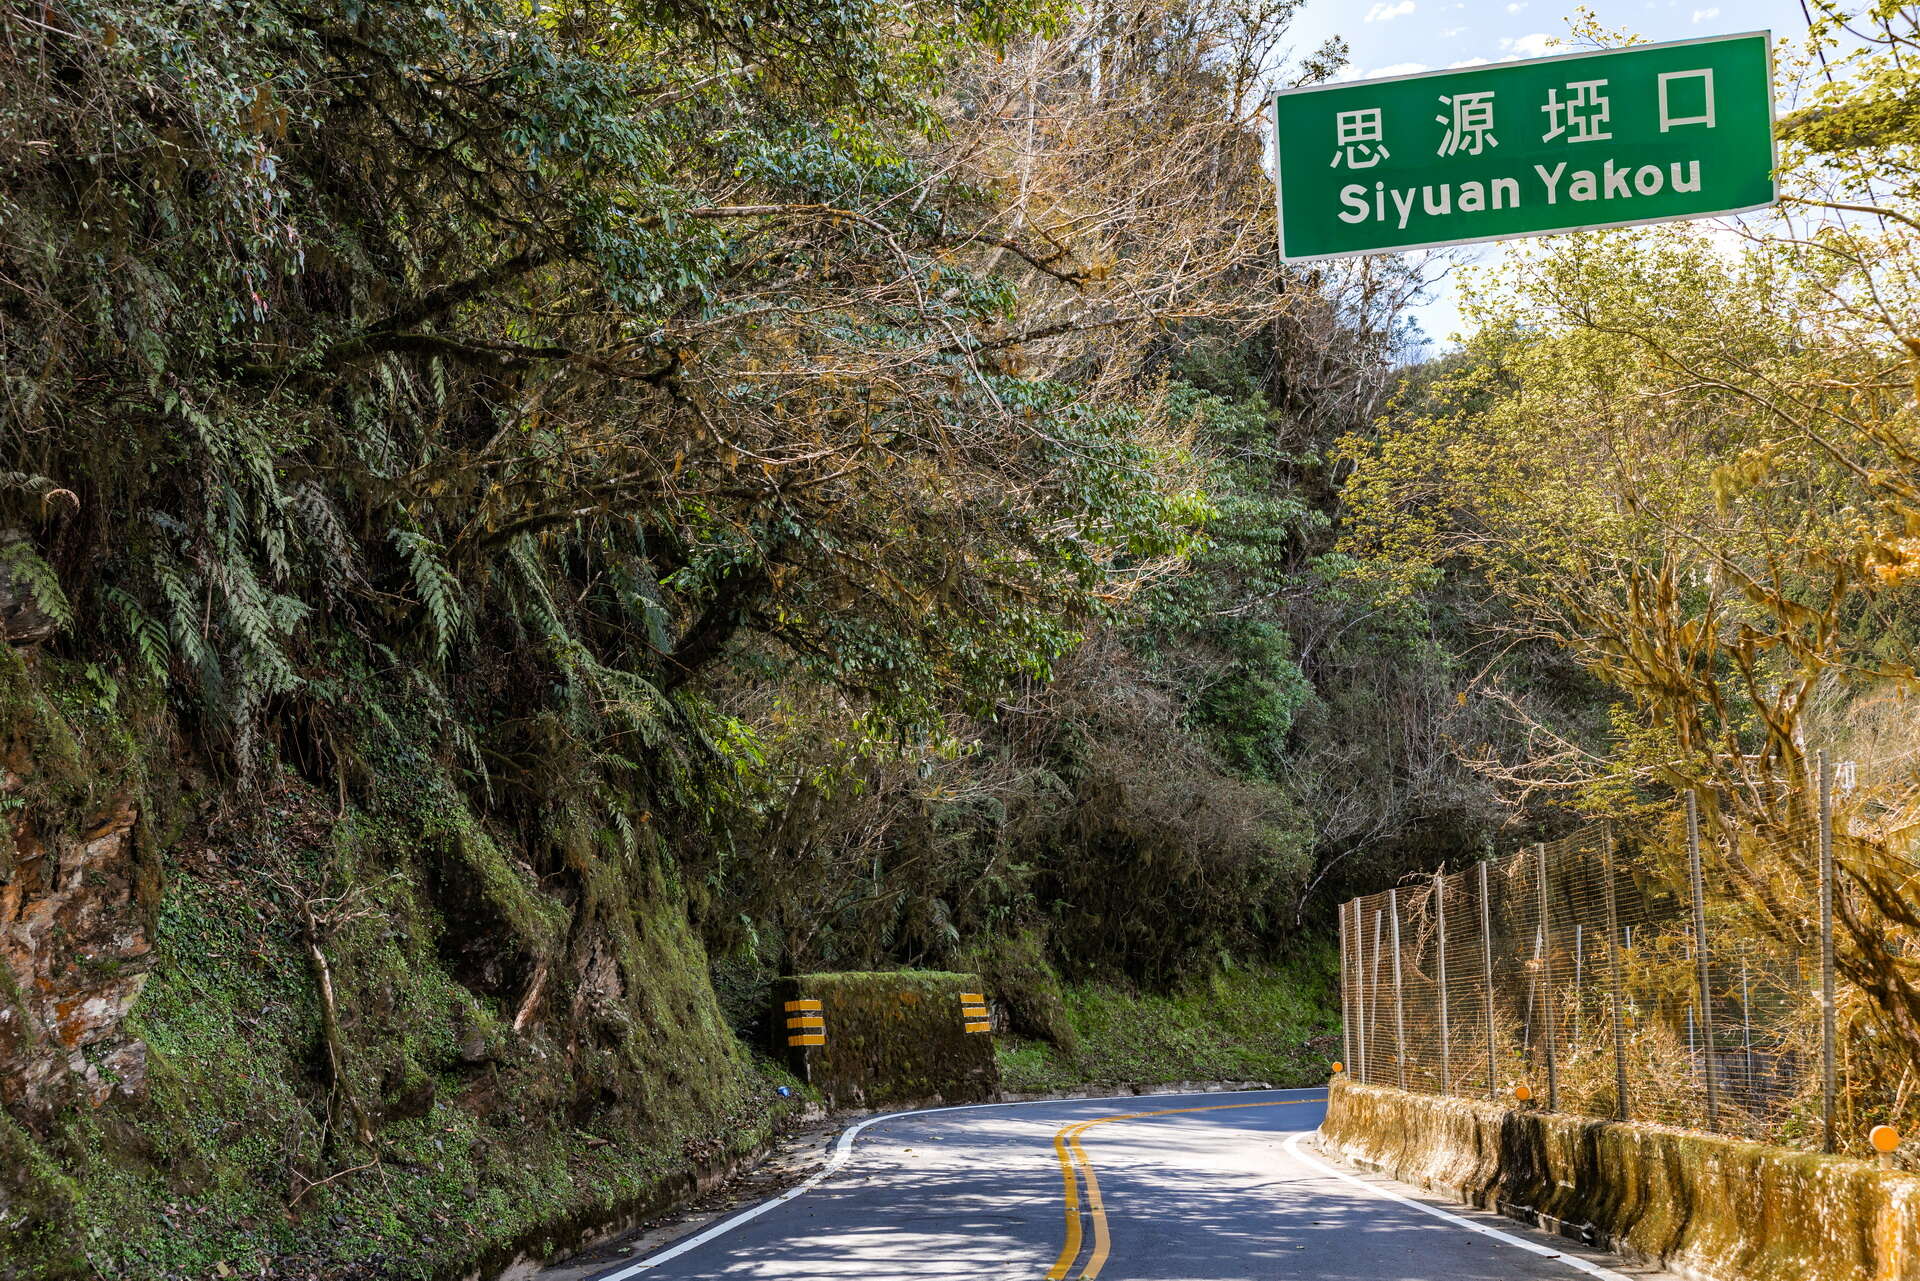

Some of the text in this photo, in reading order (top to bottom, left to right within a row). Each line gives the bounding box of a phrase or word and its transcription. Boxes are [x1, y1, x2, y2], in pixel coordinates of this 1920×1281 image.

[1330, 68, 1716, 169] 思源埡口
[1337, 158, 1701, 230] Siyuan Yakou
